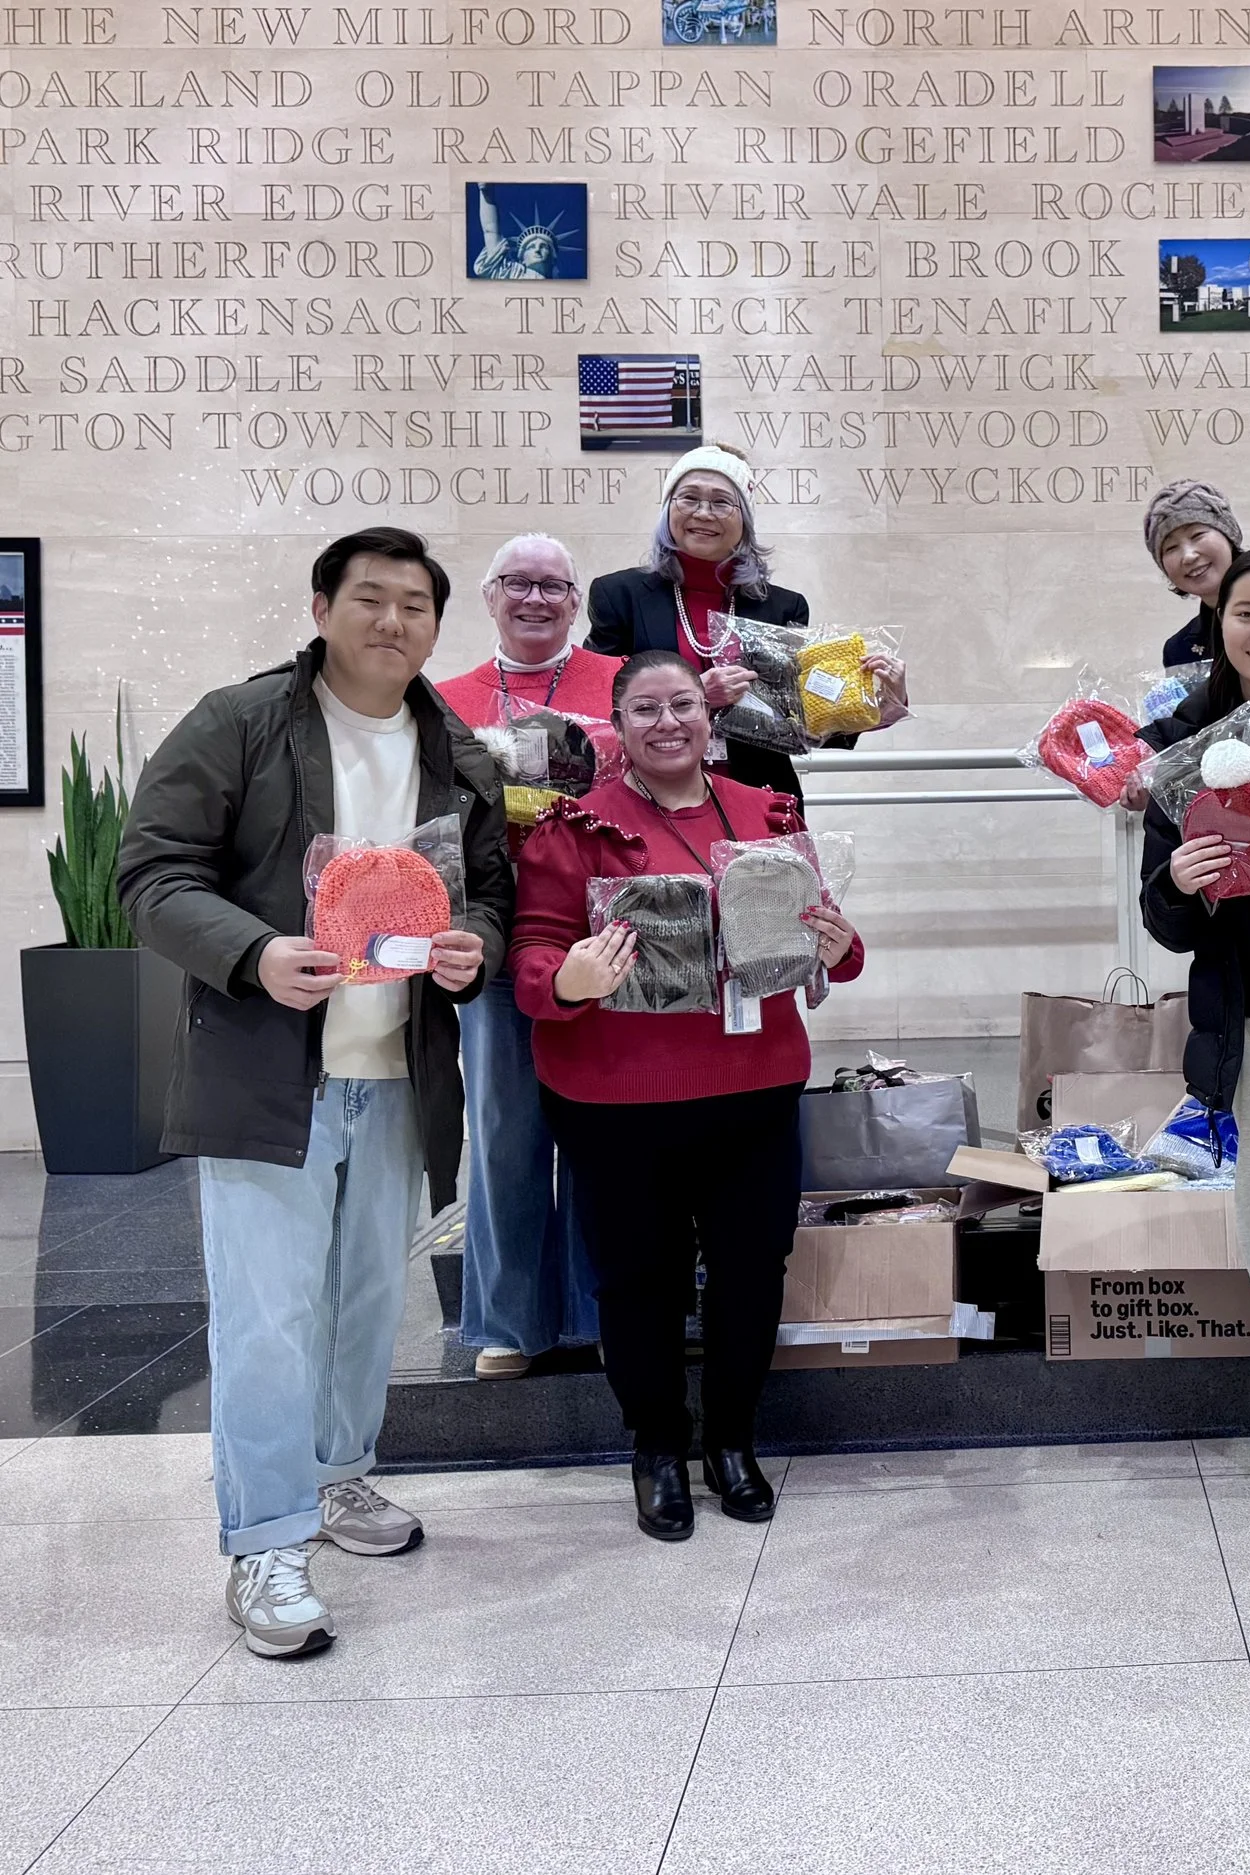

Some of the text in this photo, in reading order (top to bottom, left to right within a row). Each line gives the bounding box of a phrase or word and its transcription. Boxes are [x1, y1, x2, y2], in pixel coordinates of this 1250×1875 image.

[161, 7, 312, 46] NEW
[332, 8, 631, 46] MILFORD
[808, 8, 1032, 46] NORTH
[0, 70, 312, 109] OAKLAND
[355, 70, 489, 108] OLD
[516, 70, 773, 108] TAPPAN
[813, 70, 1125, 108] ORADELL
[0, 128, 162, 165] PARK
[187, 127, 394, 165] RIDGE
[432, 126, 698, 164] RAMSEY
[734, 126, 1125, 164] RIDGEFIELD
[28, 184, 232, 222] RIVER
[262, 184, 435, 222] EDGE
[613, 183, 812, 221] RIVER
[831, 184, 987, 220] VALE
[0, 241, 434, 280] RUTHERFORD
[615, 240, 881, 281] SADDLE
[904, 240, 1125, 278] BROOK
[28, 296, 468, 338] HACKENSACK
[505, 296, 813, 336] TEANECK
[844, 296, 1127, 336] TENAFLY
[60, 355, 322, 394] SADDLE
[352, 354, 552, 391] RIVER
[732, 354, 1099, 392] WALDWICK
[202, 410, 551, 449] TOWNSHIP
[734, 410, 1108, 449] WESTWOOD
[240, 466, 1154, 507] WOODCLIFF KE WYCKOFF
[1091, 1278, 1184, 1295] From box
[1091, 1299, 1199, 1320] to gift box.
[1090, 1320, 1250, 1339] Just. Like. That.
